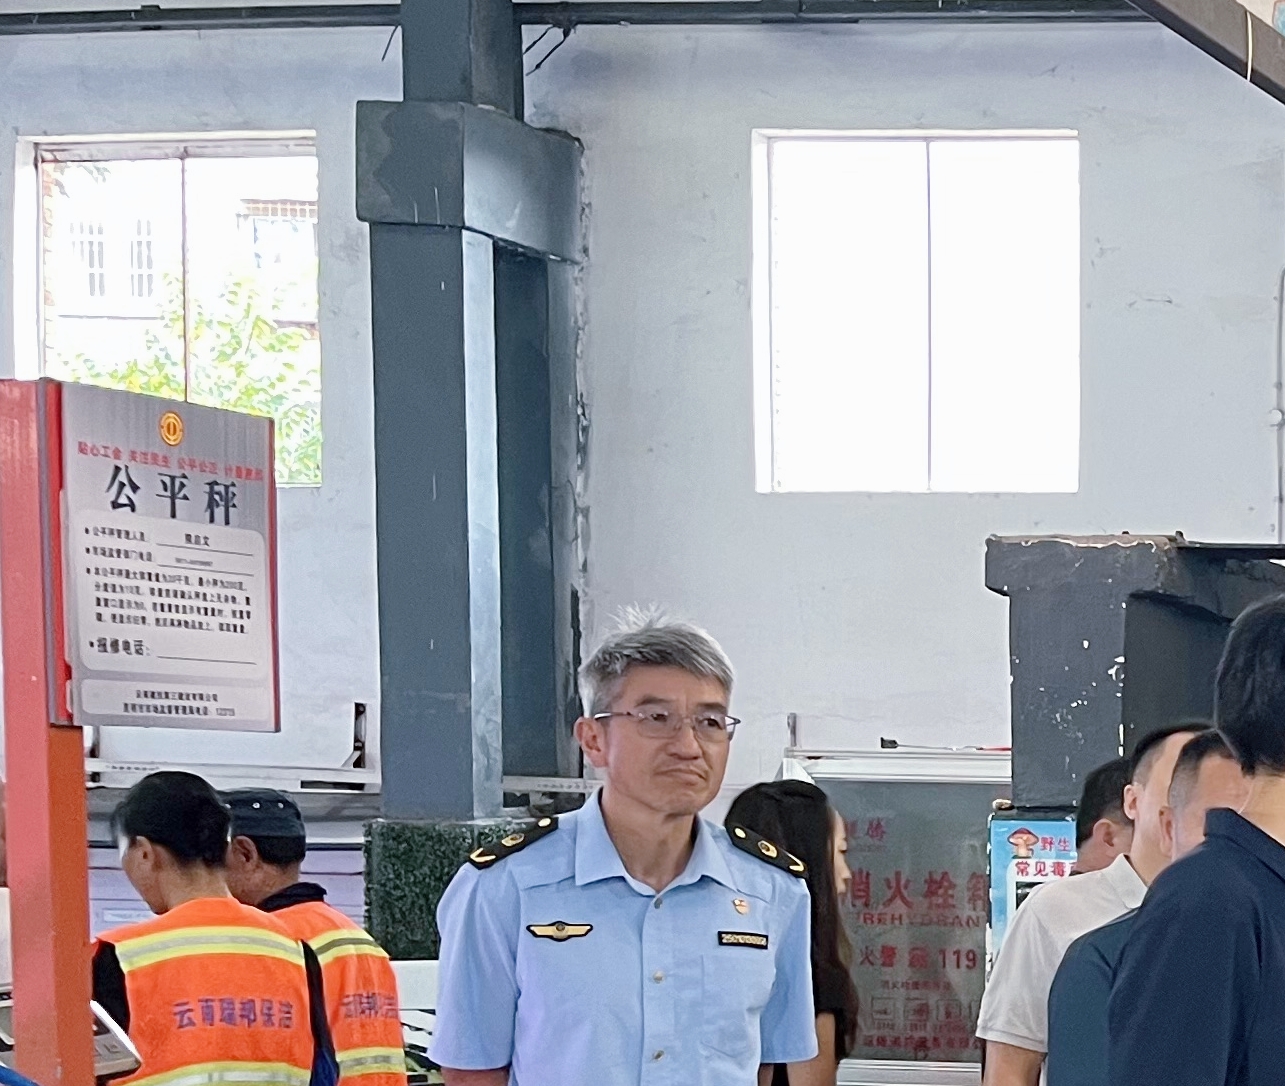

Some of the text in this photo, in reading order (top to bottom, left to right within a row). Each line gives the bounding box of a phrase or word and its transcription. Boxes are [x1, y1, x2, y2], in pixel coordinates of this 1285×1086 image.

[105, 463, 238, 526] 公平秤
[1014, 860, 1076, 878] 常见毒
[938, 948, 978, 970] 119
